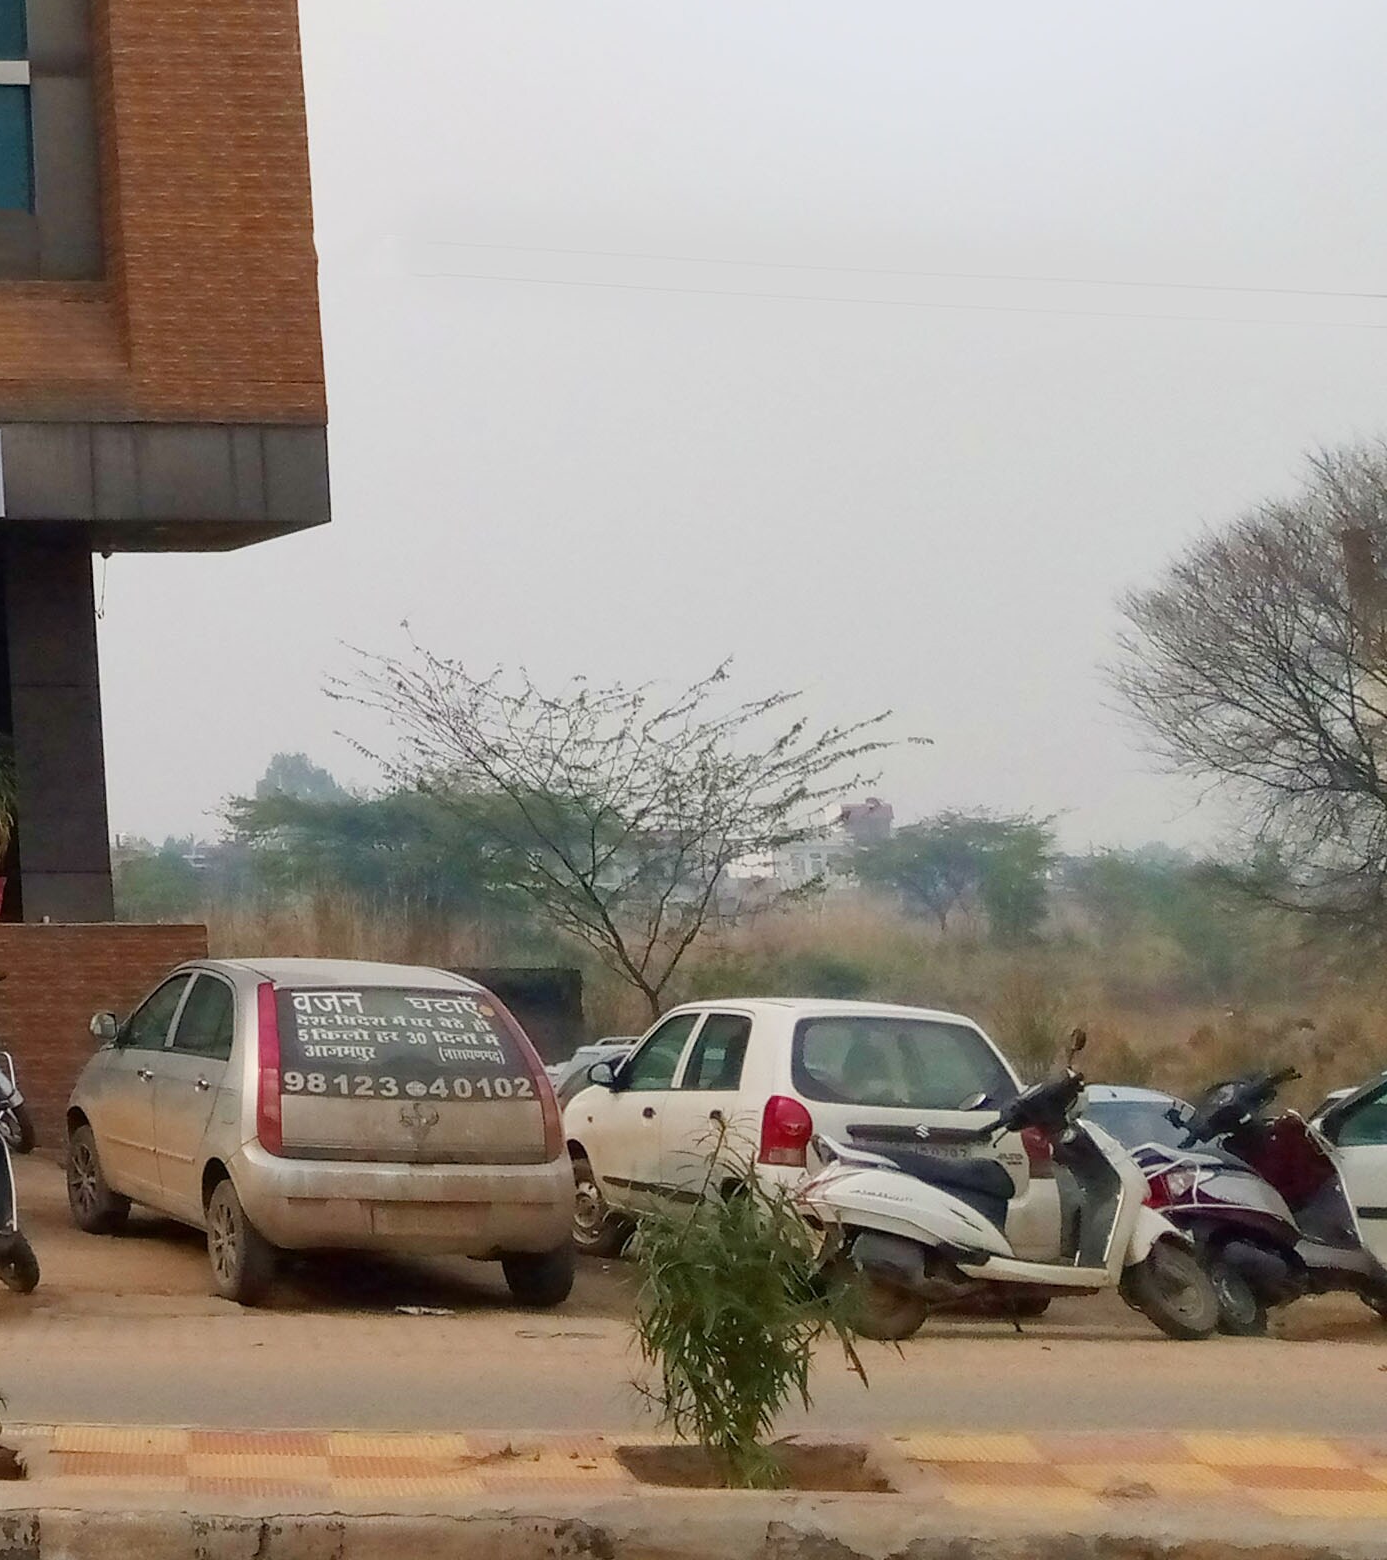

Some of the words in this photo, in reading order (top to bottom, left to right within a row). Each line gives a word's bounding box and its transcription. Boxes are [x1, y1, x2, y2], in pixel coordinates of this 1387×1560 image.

[292, 992, 364, 1014] वजन
[298, 1029, 309, 1041] 5
[406, 1032, 427, 1044] 30
[429, 1077, 535, 1099] 40102
